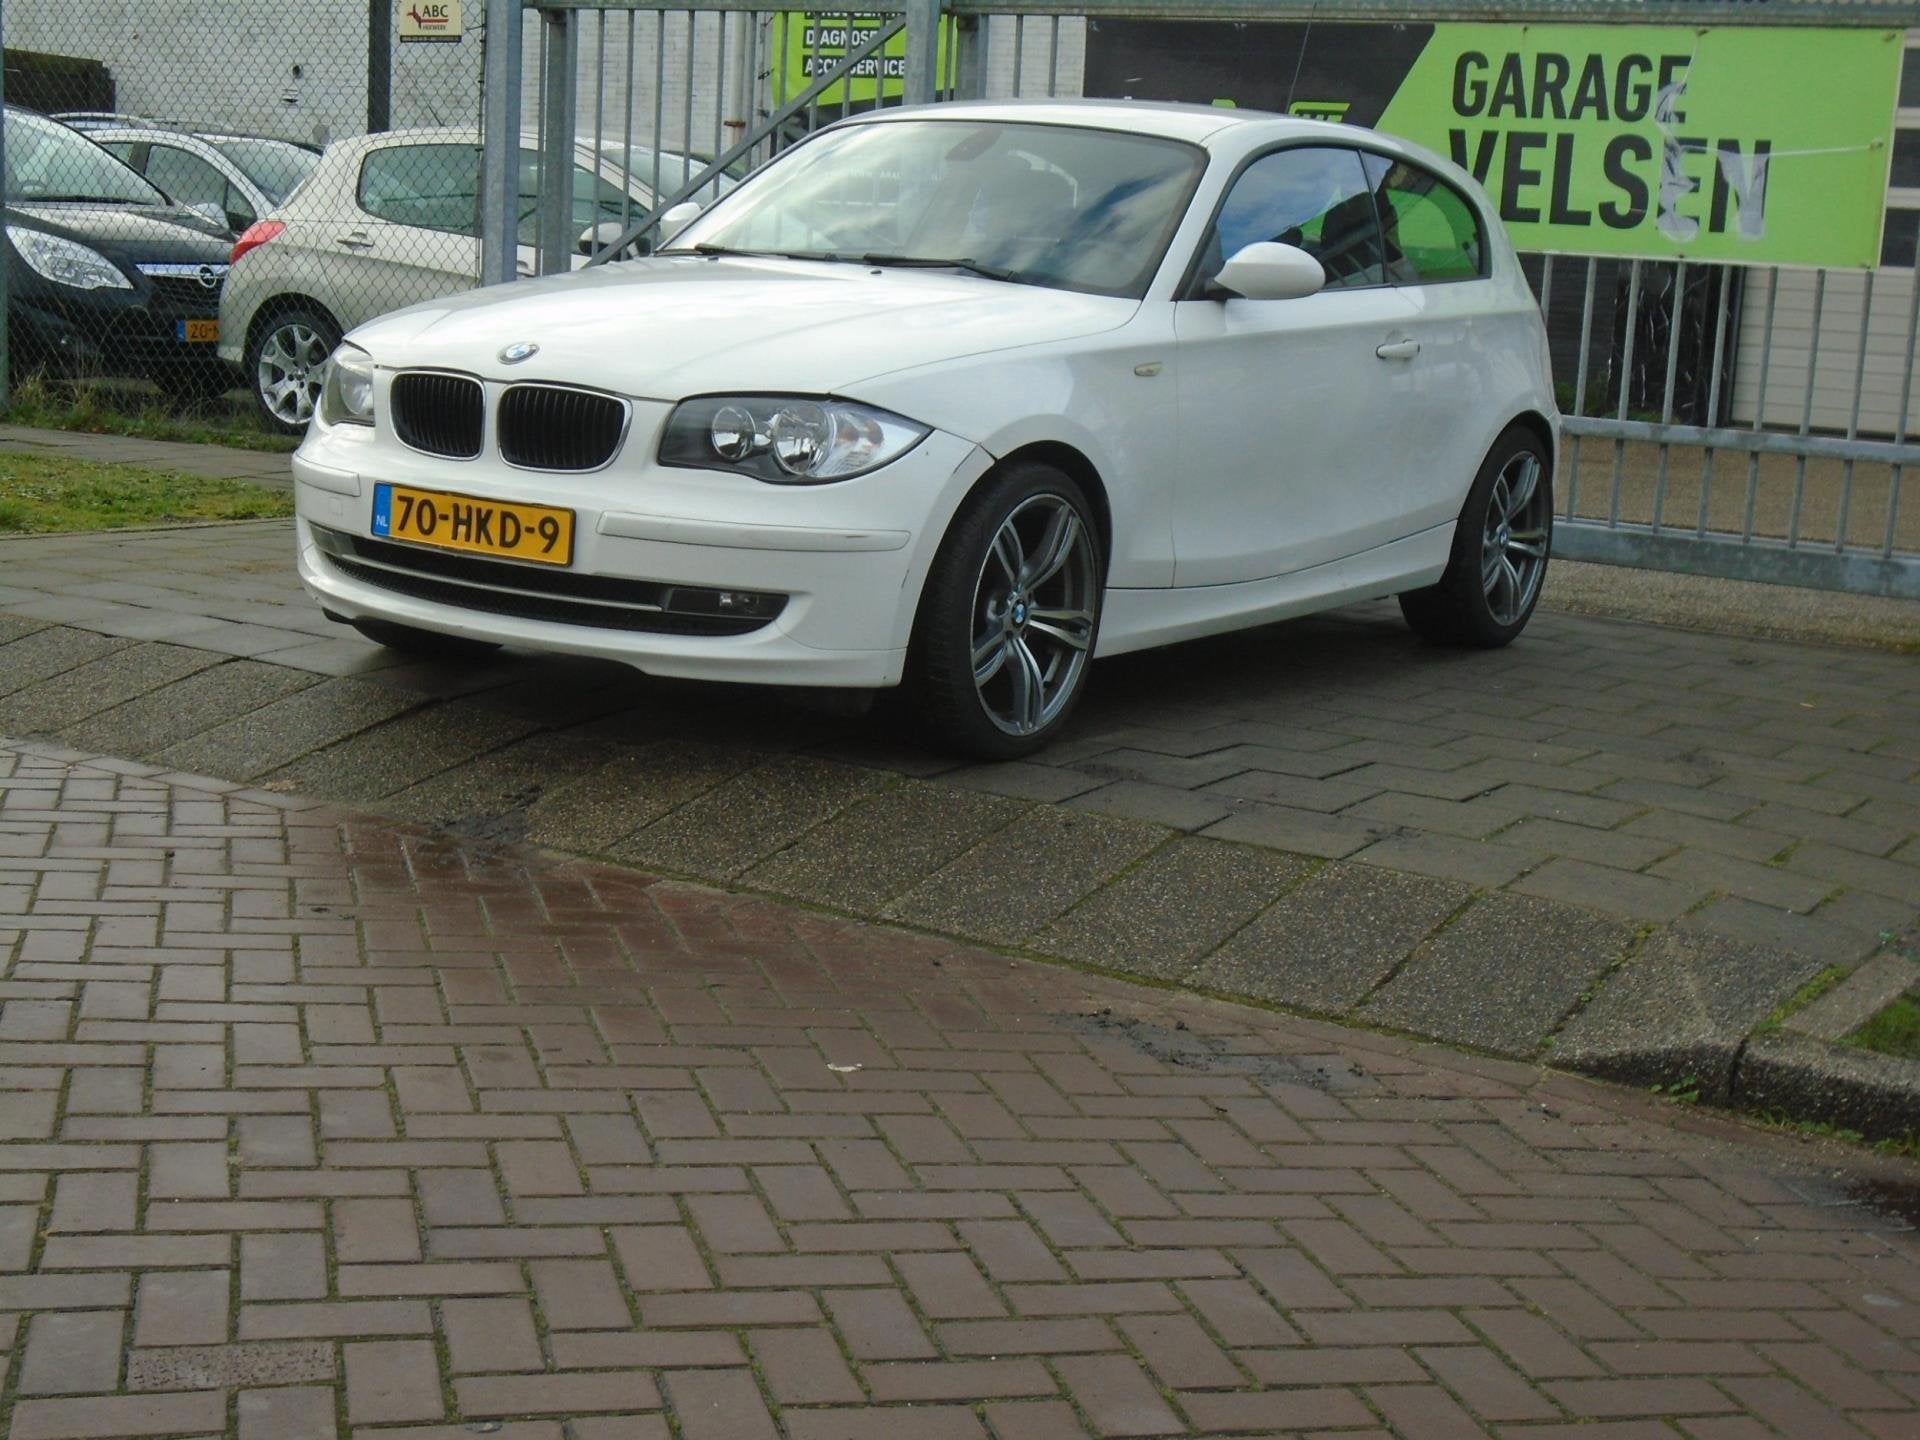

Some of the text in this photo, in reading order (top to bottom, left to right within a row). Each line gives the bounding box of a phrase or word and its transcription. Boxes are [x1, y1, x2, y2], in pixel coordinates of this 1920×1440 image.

[422, 4, 448, 17] ABC
[806, 29, 877, 45] DAGNOS
[1452, 51, 1692, 124] GARAGE
[1449, 129, 1772, 238] VELSEN
[376, 495, 560, 553] NL 70-HKD-9
